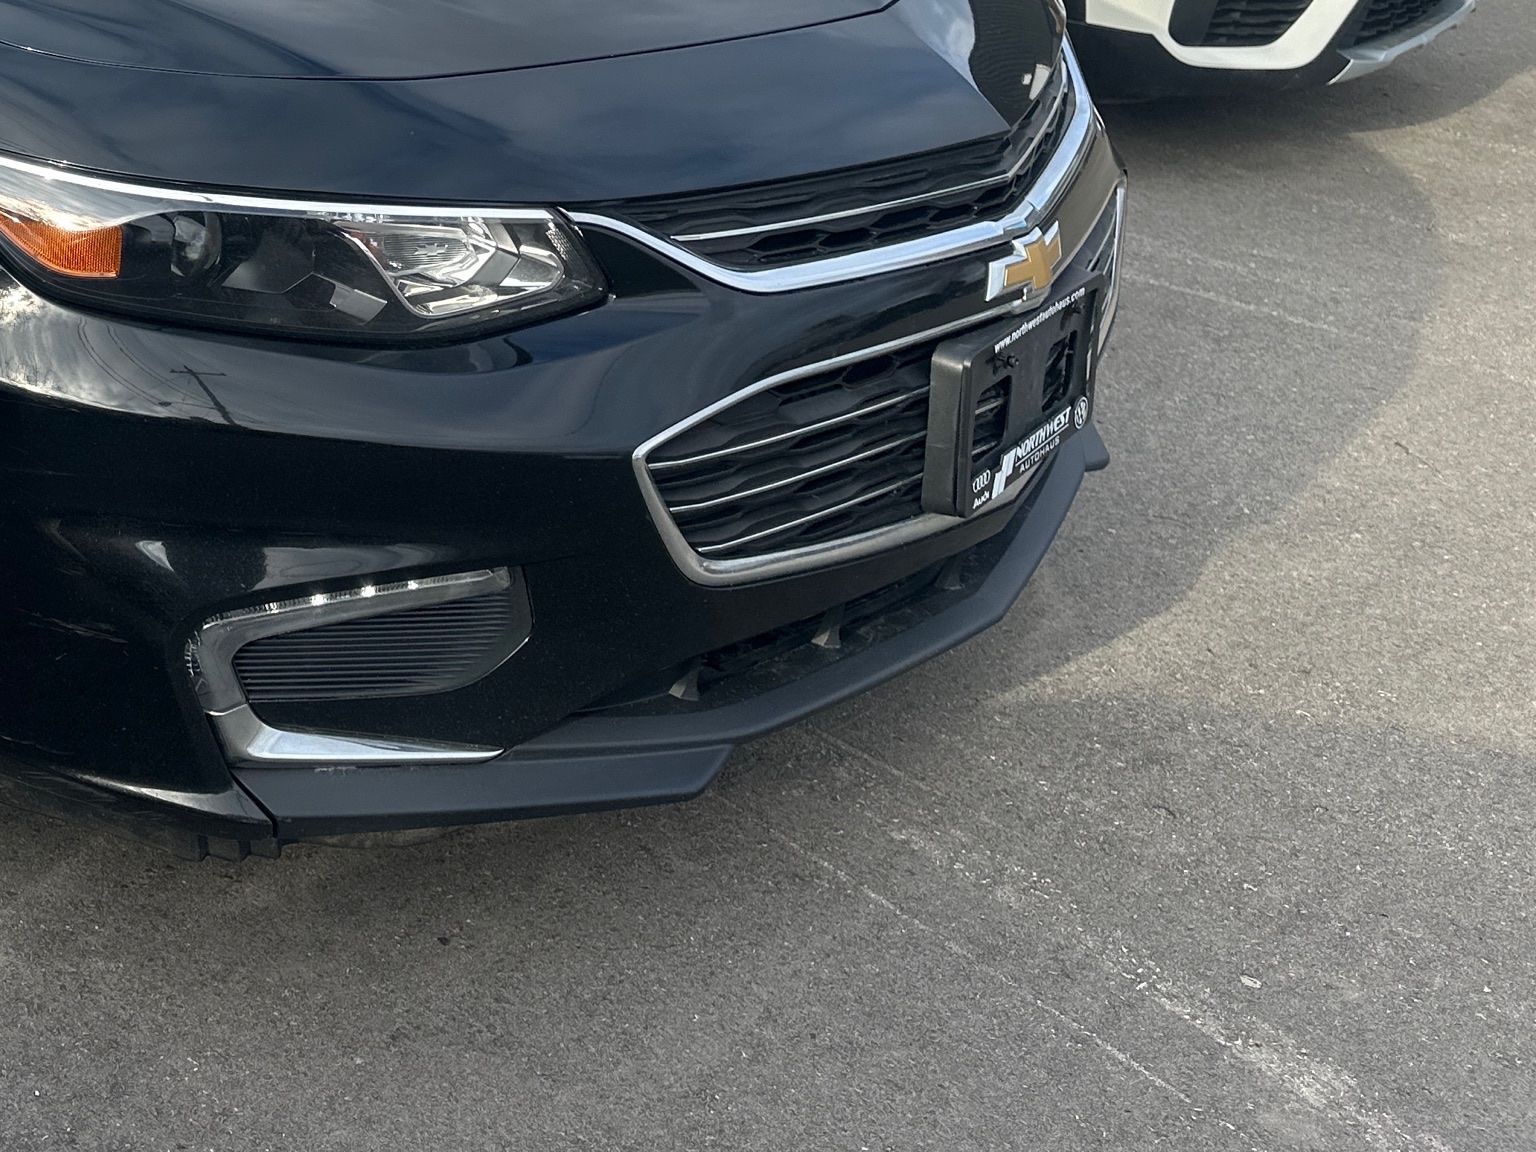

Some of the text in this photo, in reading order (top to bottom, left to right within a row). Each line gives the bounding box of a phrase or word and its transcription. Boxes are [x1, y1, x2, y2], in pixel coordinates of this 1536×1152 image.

[994, 287, 1086, 354] www.northwestautohaus.com
[1015, 406, 1072, 462] NORTHWEST
[1019, 435, 1060, 473] AUTOHAUS
[972, 490, 990, 510] Audi
